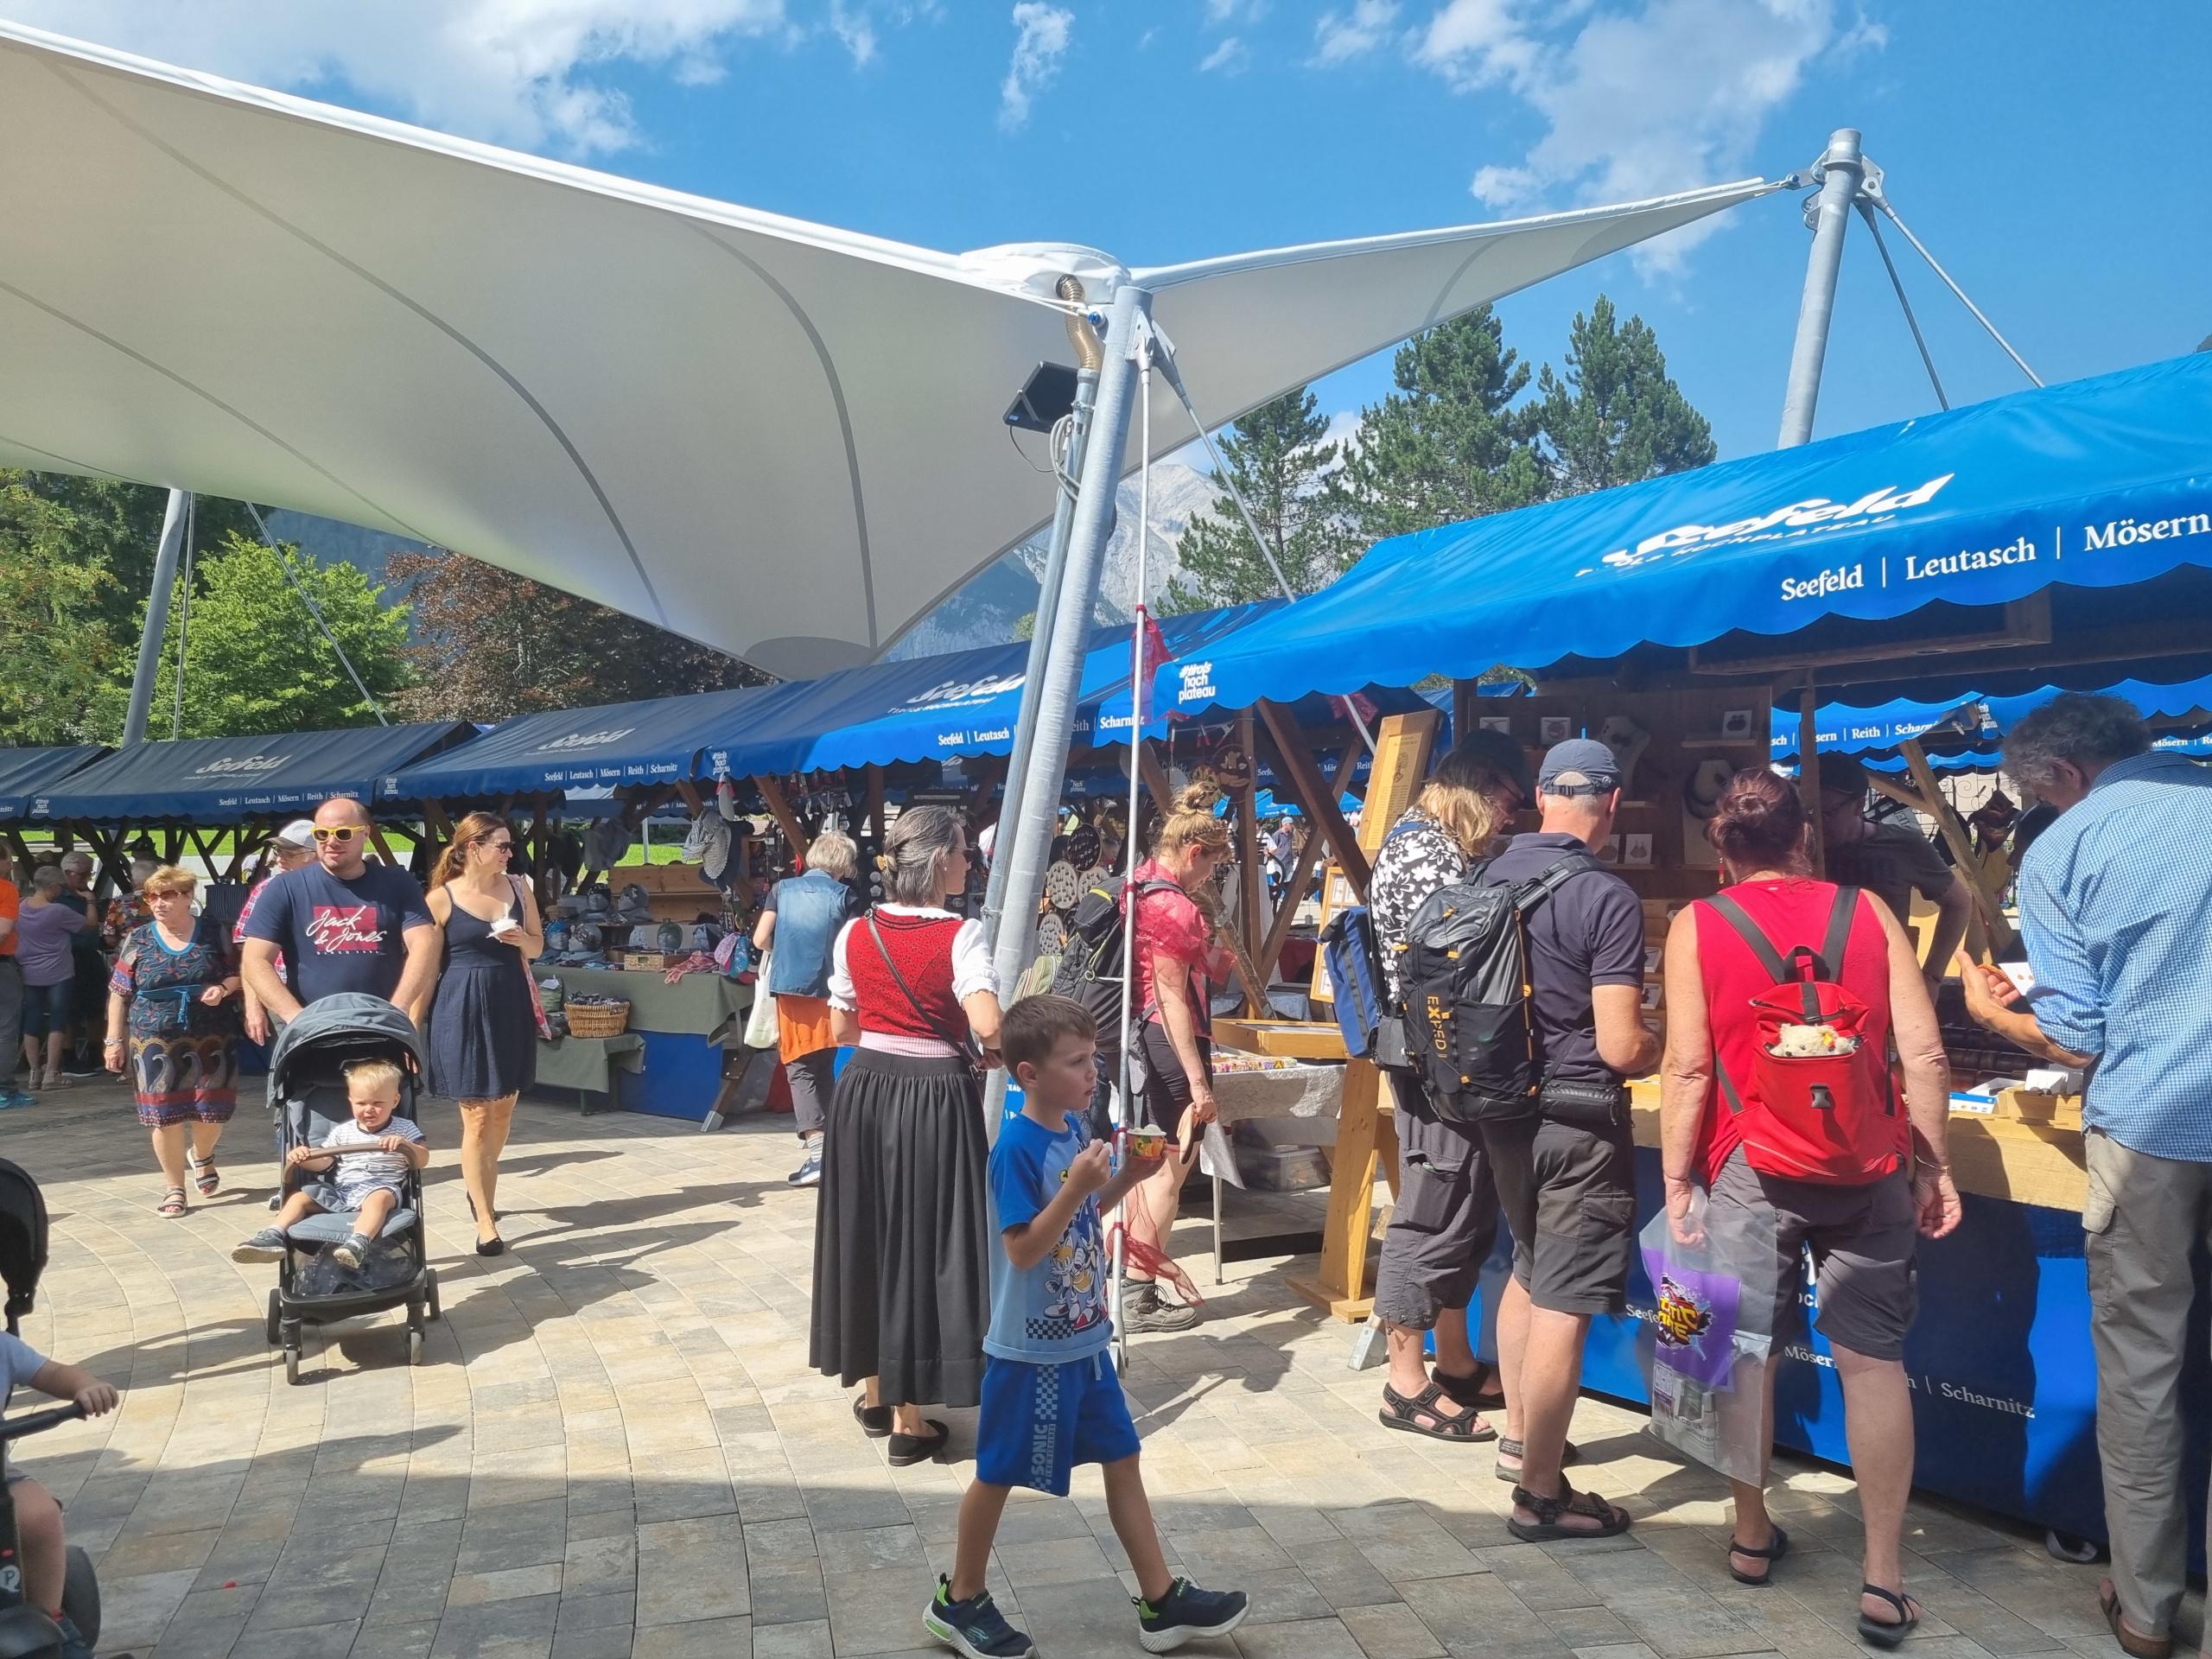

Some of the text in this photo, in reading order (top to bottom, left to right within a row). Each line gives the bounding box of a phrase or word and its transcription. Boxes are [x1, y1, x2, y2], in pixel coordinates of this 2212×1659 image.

[1781, 513, 2212, 601] Seefeld Leutasch Mösern
[1179, 685, 1216, 704] plateau
[1184, 675, 1208, 691] hoch
[938, 715, 1145, 746] Seefeld Leutasch eith Scharniz
[1815, 732, 1837, 743] sern
[1852, 725, 1881, 740] Reith
[544, 771, 563, 782] Seefeld
[569, 769, 594, 780] Leutasch
[627, 764, 644, 776] Reith
[650, 762, 678, 774] Scharnitz
[245, 795, 270, 804] Leutasch
[307, 791, 323, 801] Reith
[306, 905, 367, 937] Jack
[314, 927, 388, 953] & Jones
[1625, 1304, 1660, 1324] Seefe
[1940, 1382, 2036, 1419] Scharnitz
[1031, 1423, 1048, 1477] SONIC
